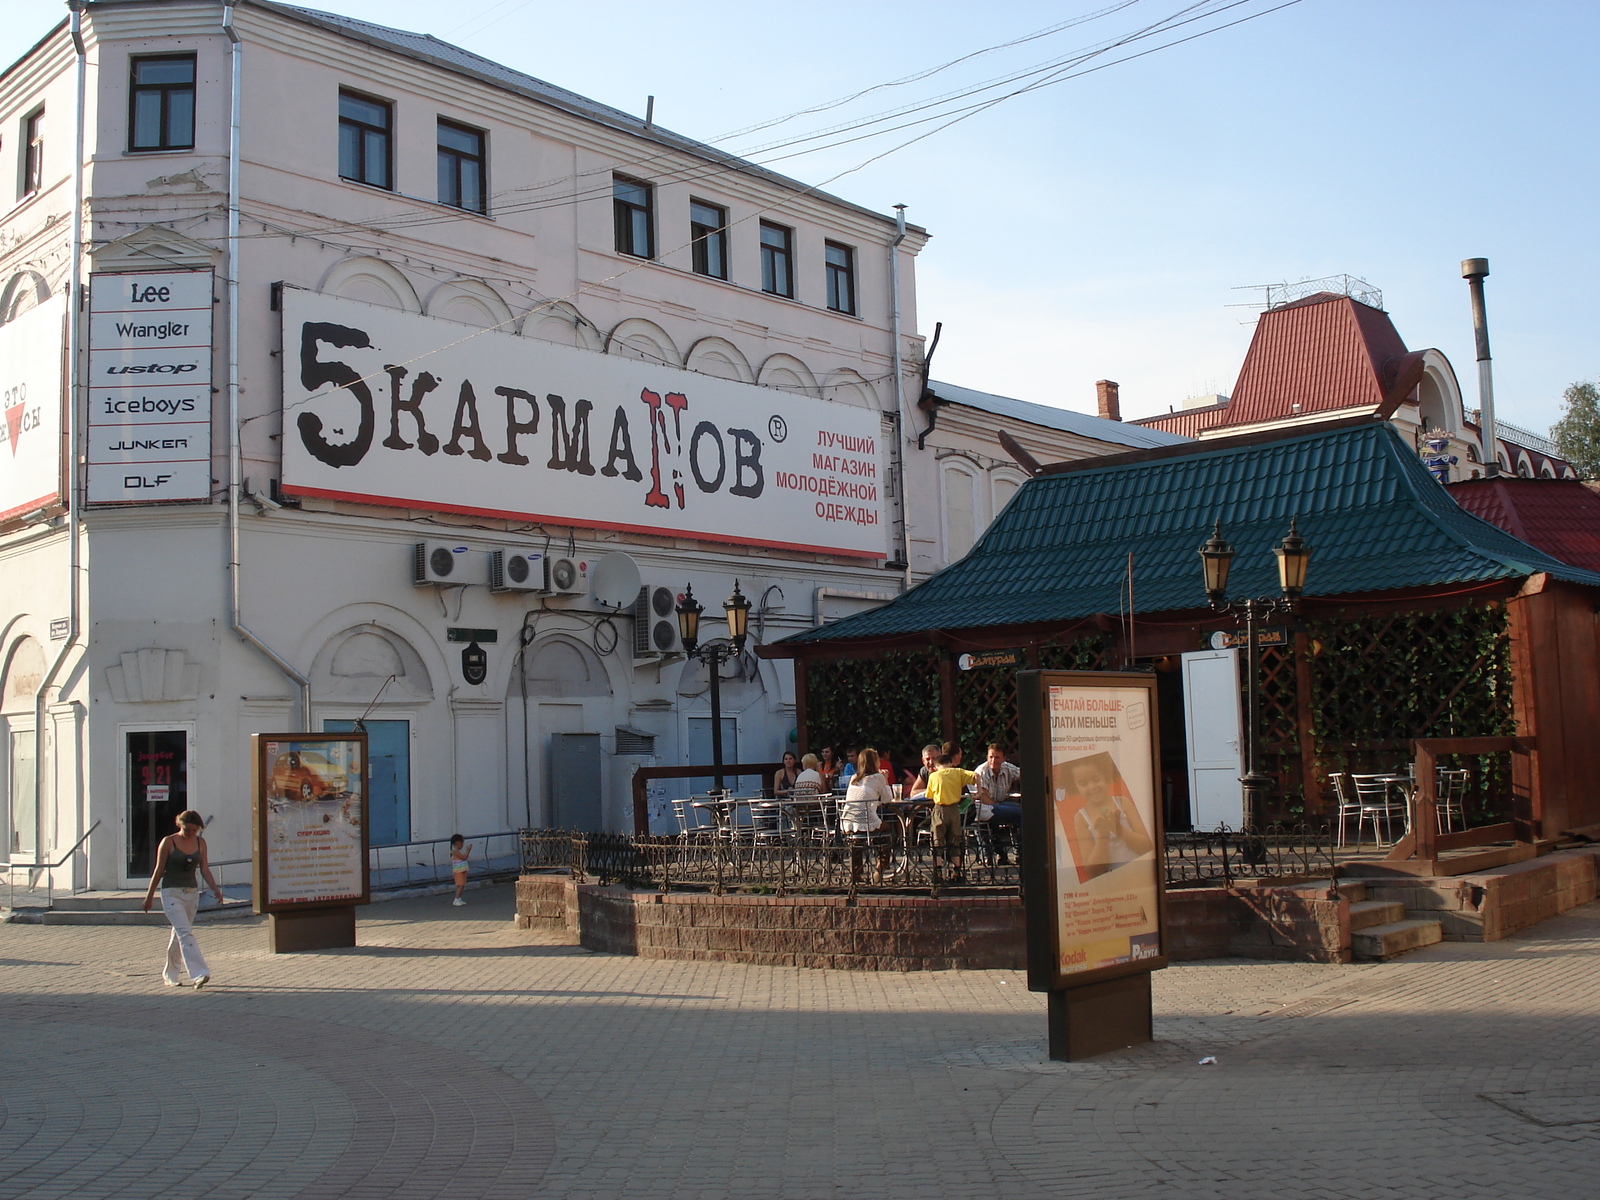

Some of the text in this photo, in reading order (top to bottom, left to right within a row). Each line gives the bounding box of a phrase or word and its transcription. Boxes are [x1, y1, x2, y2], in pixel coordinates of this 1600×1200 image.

[131, 283, 170, 303] Lee
[116, 321, 189, 340] Wrangler
[4, 382, 27, 409] ЭТО
[105, 396, 195, 415] iceboys
[109, 438, 188, 451] JUNKER
[817, 430, 875, 455] ЛУЧШИЙ
[812, 453, 876, 478] МАГАЗИН
[776, 471, 877, 502] МОЛОДЁЖНОЙ
[815, 501, 878, 526] ОДЕЖДЫ
[1077, 716, 1117, 728] МЕНЬШЕ!
[1060, 949, 1087, 966] Kodak
